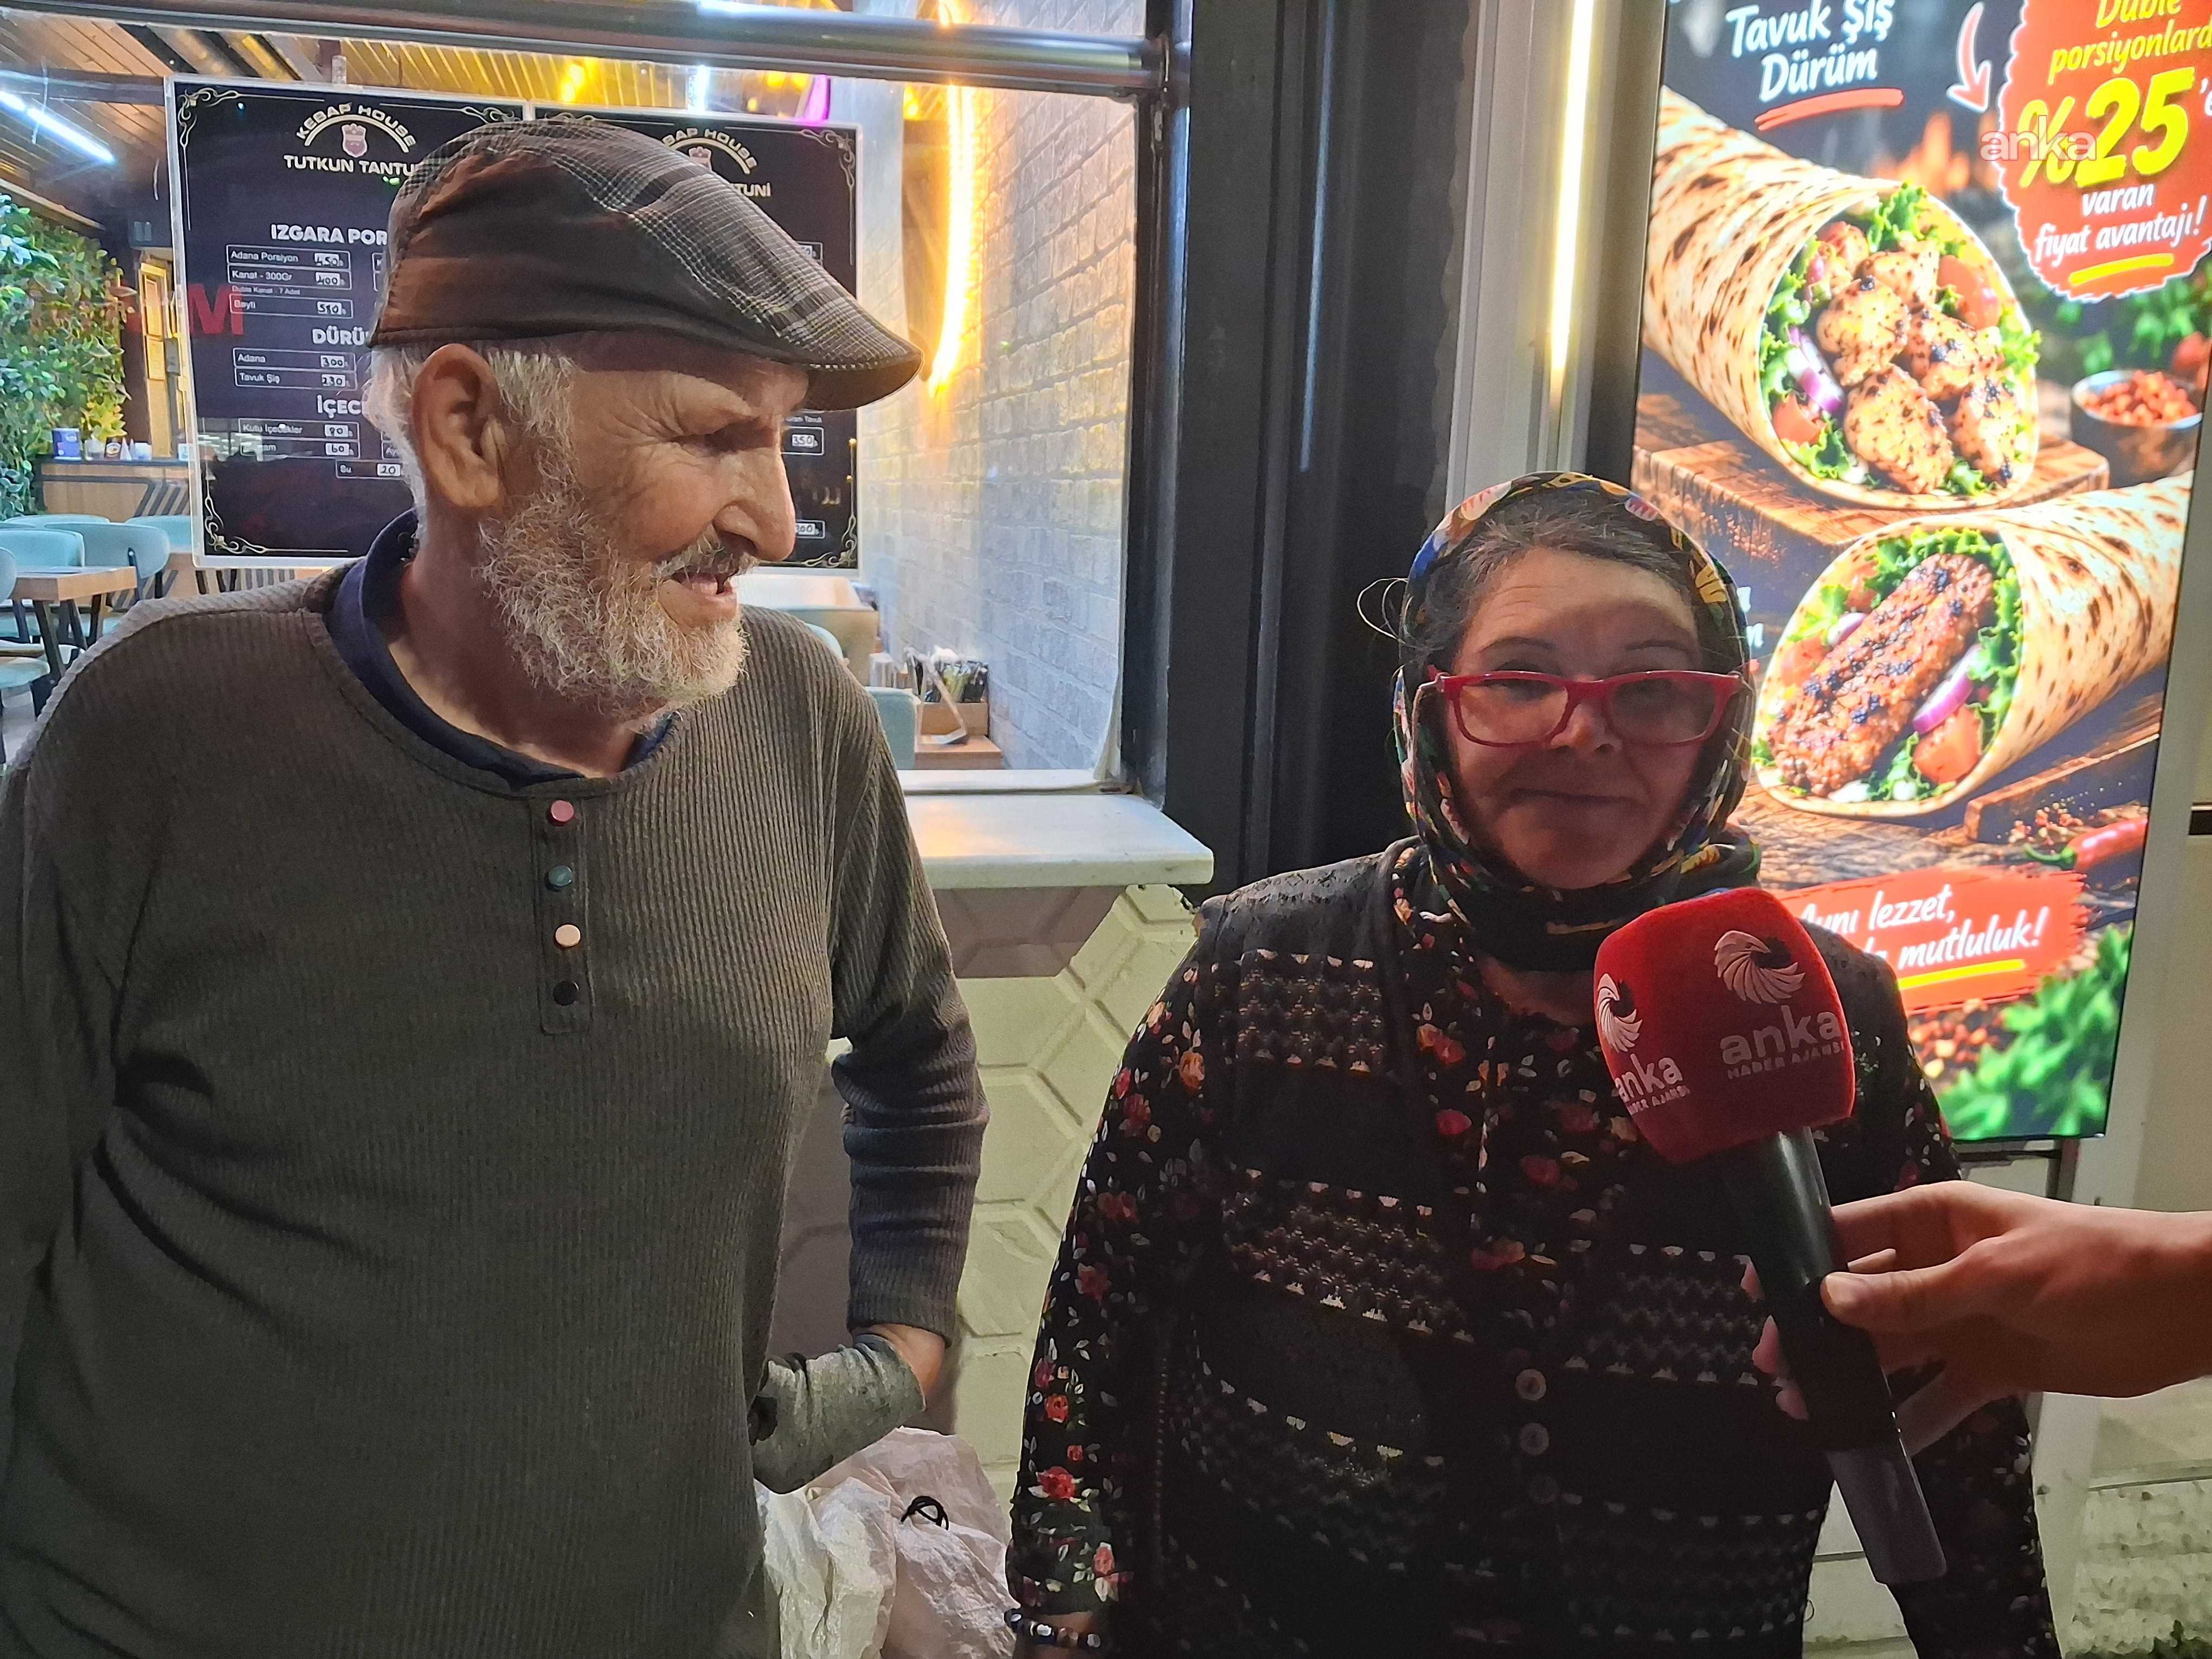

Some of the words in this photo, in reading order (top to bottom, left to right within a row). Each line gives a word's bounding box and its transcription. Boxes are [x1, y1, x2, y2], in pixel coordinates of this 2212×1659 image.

[1725, 0, 1831, 58] Tavuk
[2047, 13, 2212, 86] porsiyonlard
[1758, 42, 1878, 103] Dürüm
[296, 102, 352, 139] KEBAP
[358, 105, 416, 147] HOUSE
[662, 127, 698, 147] BAP
[283, 155, 354, 173] TUTKUN
[358, 160, 417, 177] TANTU
[731, 182, 771, 197] TUNİ
[2082, 183, 2155, 216] varan
[271, 224, 345, 243] IZGARA
[348, 228, 387, 246] POR
[2035, 222, 2092, 267] fiyat
[2095, 195, 2208, 248] avantajı!
[231, 250, 259, 260] Adana
[261, 252, 299, 263] Porsiyon
[232, 270, 258, 279] Kanat
[312, 325, 368, 346] DÜRÜ
[317, 394, 362, 419] İÇEC
[1868, 883, 1956, 930] lezzet,
[1898, 906, 2050, 970] mutluluk!
[1720, 1005, 1842, 1065] anka
[1614, 1053, 1683, 1103] anka
